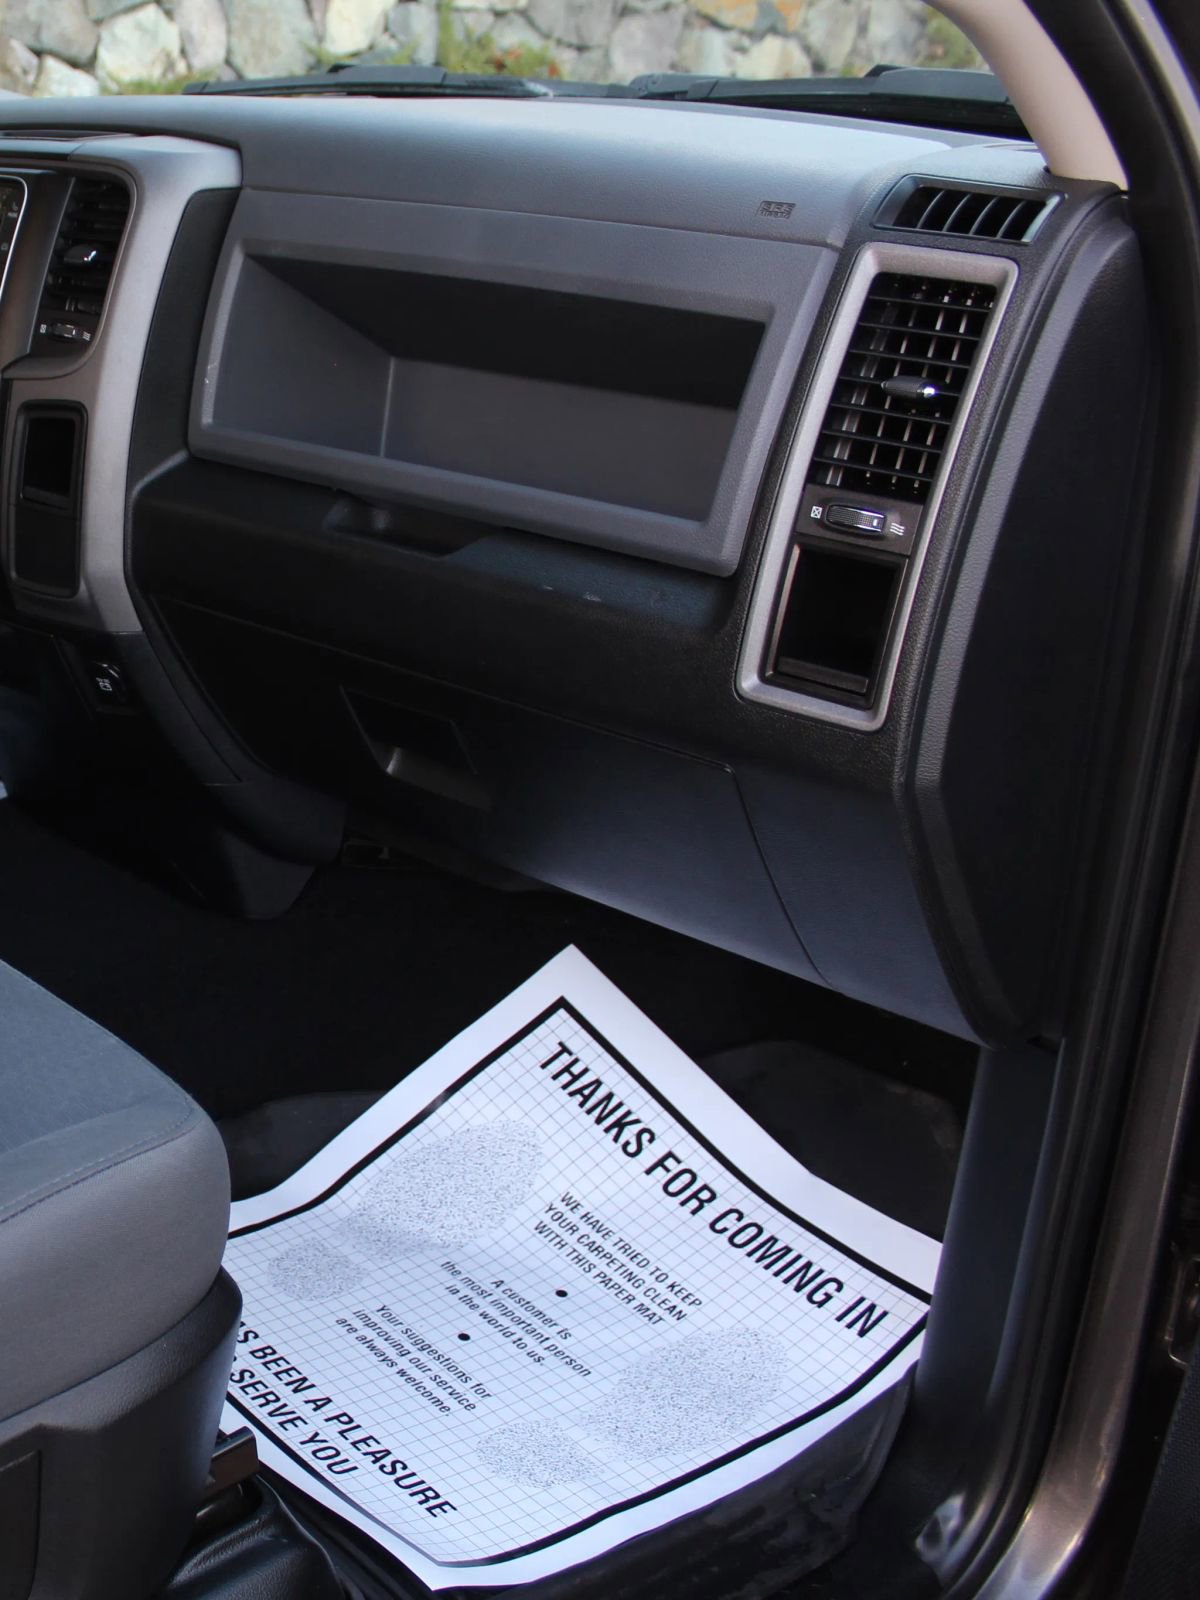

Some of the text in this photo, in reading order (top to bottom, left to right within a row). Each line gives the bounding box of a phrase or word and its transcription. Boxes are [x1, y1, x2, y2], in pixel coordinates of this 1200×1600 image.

[539, 1041, 889, 1338] THANKS FOR COMING IN
[534, 1220, 666, 1326] WITH THIS PAPER MAT
[544, 1203, 687, 1321] YOUR CARPETING CLEAN
[560, 1191, 703, 1308] WE HAVE TRIED TO KEEP
[352, 1309, 477, 1412] improving our service
[376, 1305, 493, 1400] Your suggestions for
[440, 1261, 592, 1377] the most important person
[445, 1284, 545, 1367] in the world to us.
[490, 1279, 572, 1341] A customer is
[335, 1317, 452, 1417] are always welcome.
[230, 1368, 359, 1475] SERVE YOU
[249, 1344, 317, 1394] BEEN
[304, 1396, 333, 1412] A
[324, 1412, 457, 1518] PLEASURE
